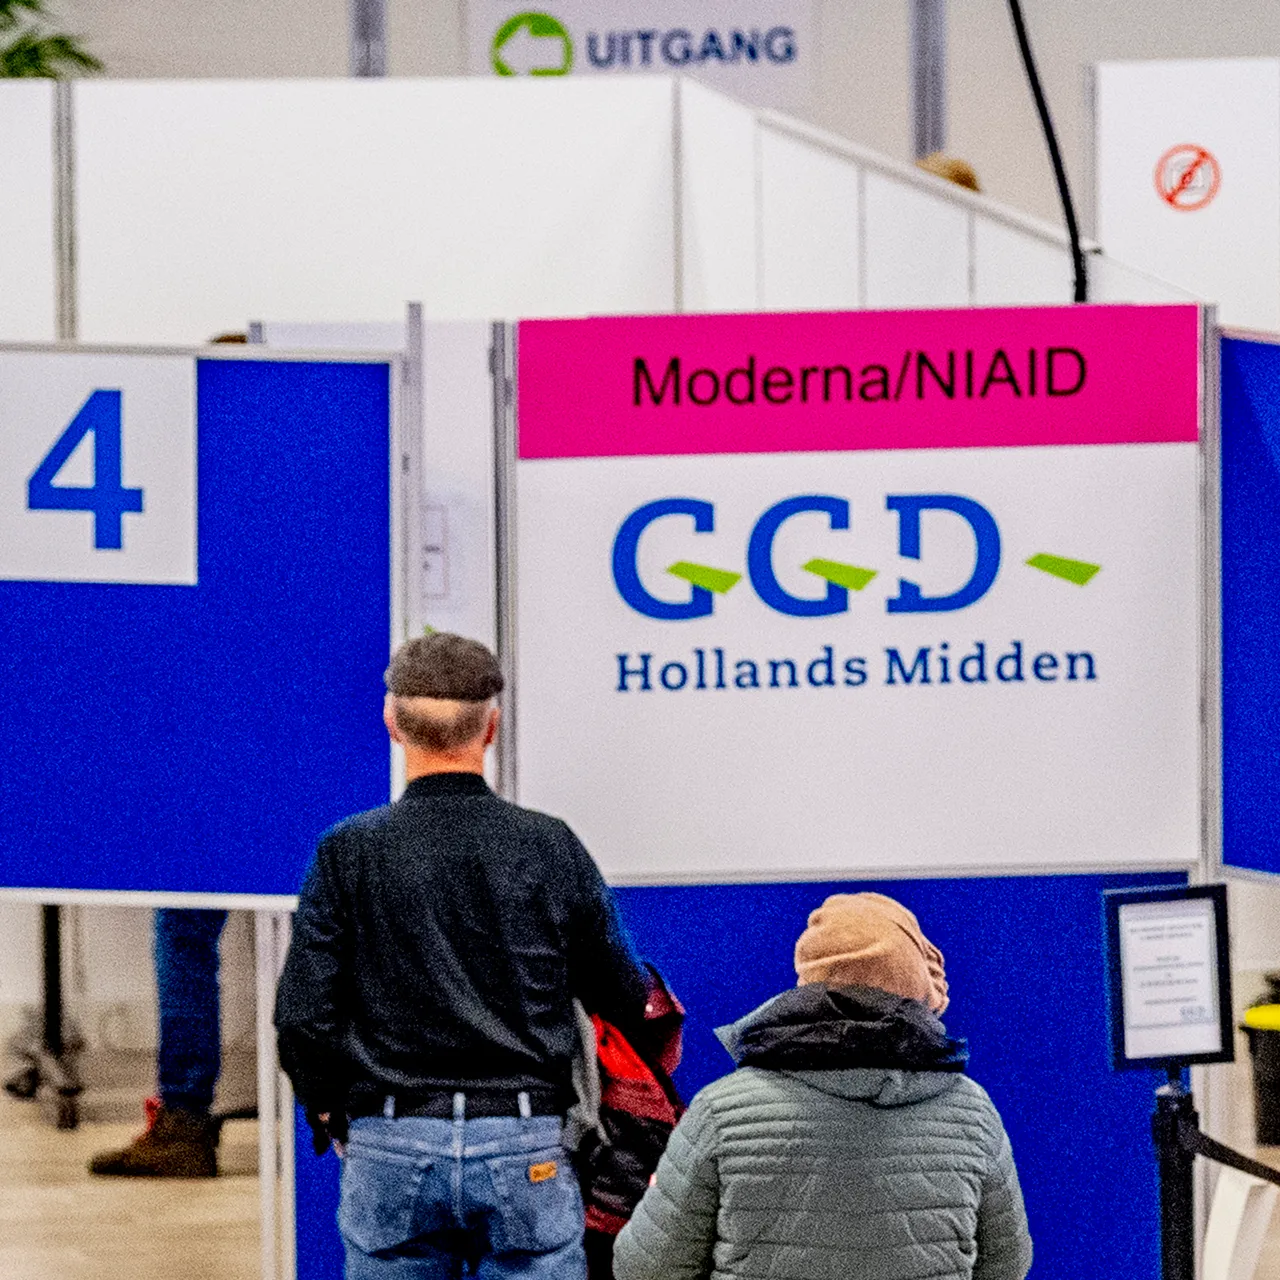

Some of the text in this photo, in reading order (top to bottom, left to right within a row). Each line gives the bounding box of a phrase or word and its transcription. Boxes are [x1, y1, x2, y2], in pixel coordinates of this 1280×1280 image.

[586, 27, 797, 68] UITGANG
[632, 347, 1088, 408] Moderna/NIAID
[26, 388, 144, 551] 4
[611, 494, 1002, 621] GGD
[616, 640, 1098, 693] Hollands Midden
